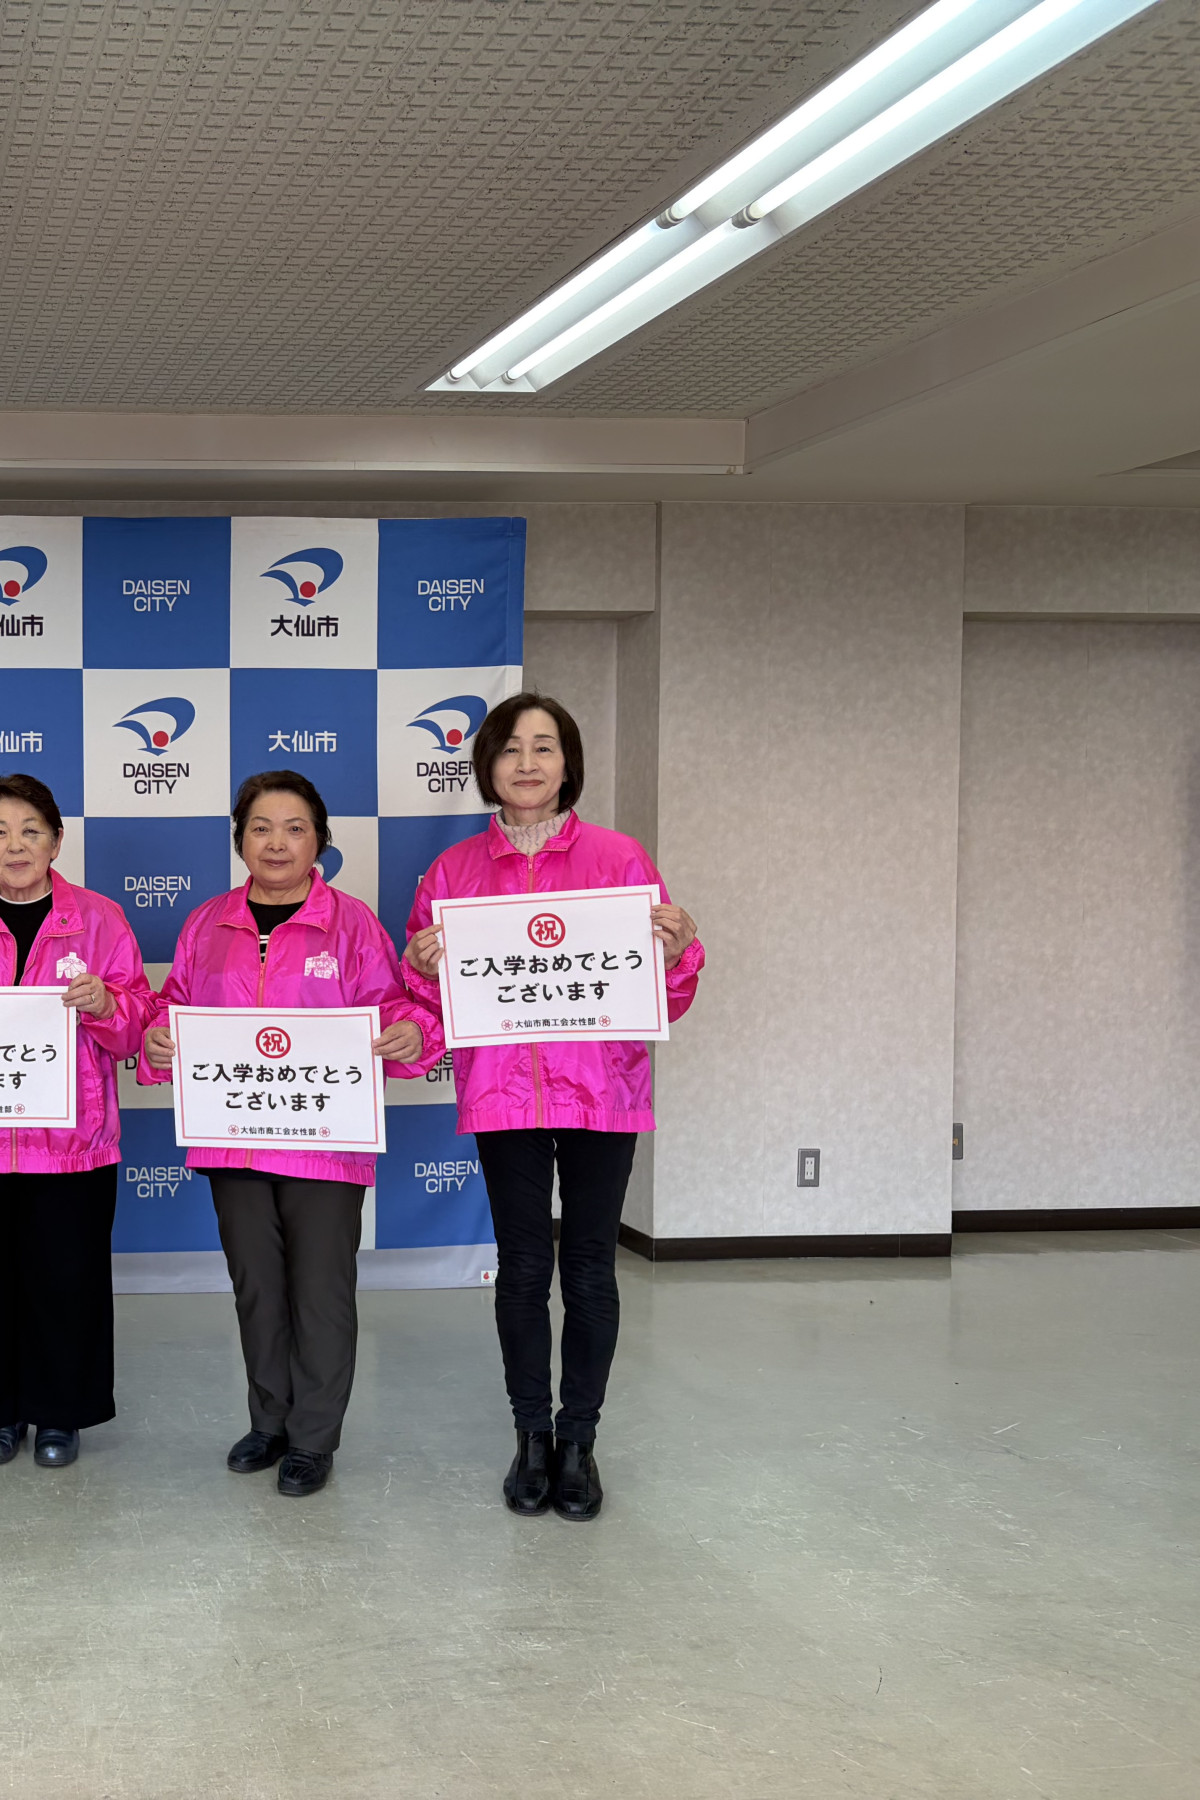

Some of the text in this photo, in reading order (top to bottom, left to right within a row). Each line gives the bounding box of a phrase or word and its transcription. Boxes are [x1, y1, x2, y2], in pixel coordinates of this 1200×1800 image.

[122, 579, 190, 596] DAISEN
[417, 578, 484, 596] DAISEN
[133, 596, 177, 612] CITY
[428, 596, 472, 612] CITY
[270, 614, 339, 638] 大仙市
[268, 730, 337, 753] 大仙市
[123, 762, 190, 779] DAISEN
[134, 779, 177, 795] CITY
[427, 777, 469, 793] CITY
[124, 875, 191, 893] DAISEN
[135, 893, 179, 909] CITY
[534, 920, 559, 942] 祝
[459, 949, 643, 978] ご入学おめでとう
[497, 980, 610, 1004] ございます
[514, 1017, 597, 1029] 大仙市商工会女性部
[262, 1032, 285, 1053] 祝
[192, 1063, 363, 1085] ご入学おめでとう
[425, 1067, 454, 1083] CIT
[225, 1091, 331, 1113] ございます
[240, 1126, 317, 1137] 大仙市商工会女性部
[126, 1166, 193, 1182] DAISEN
[414, 1159, 480, 1178] DAISEN
[136, 1182, 179, 1198] CITY
[425, 1176, 467, 1194] CITY
